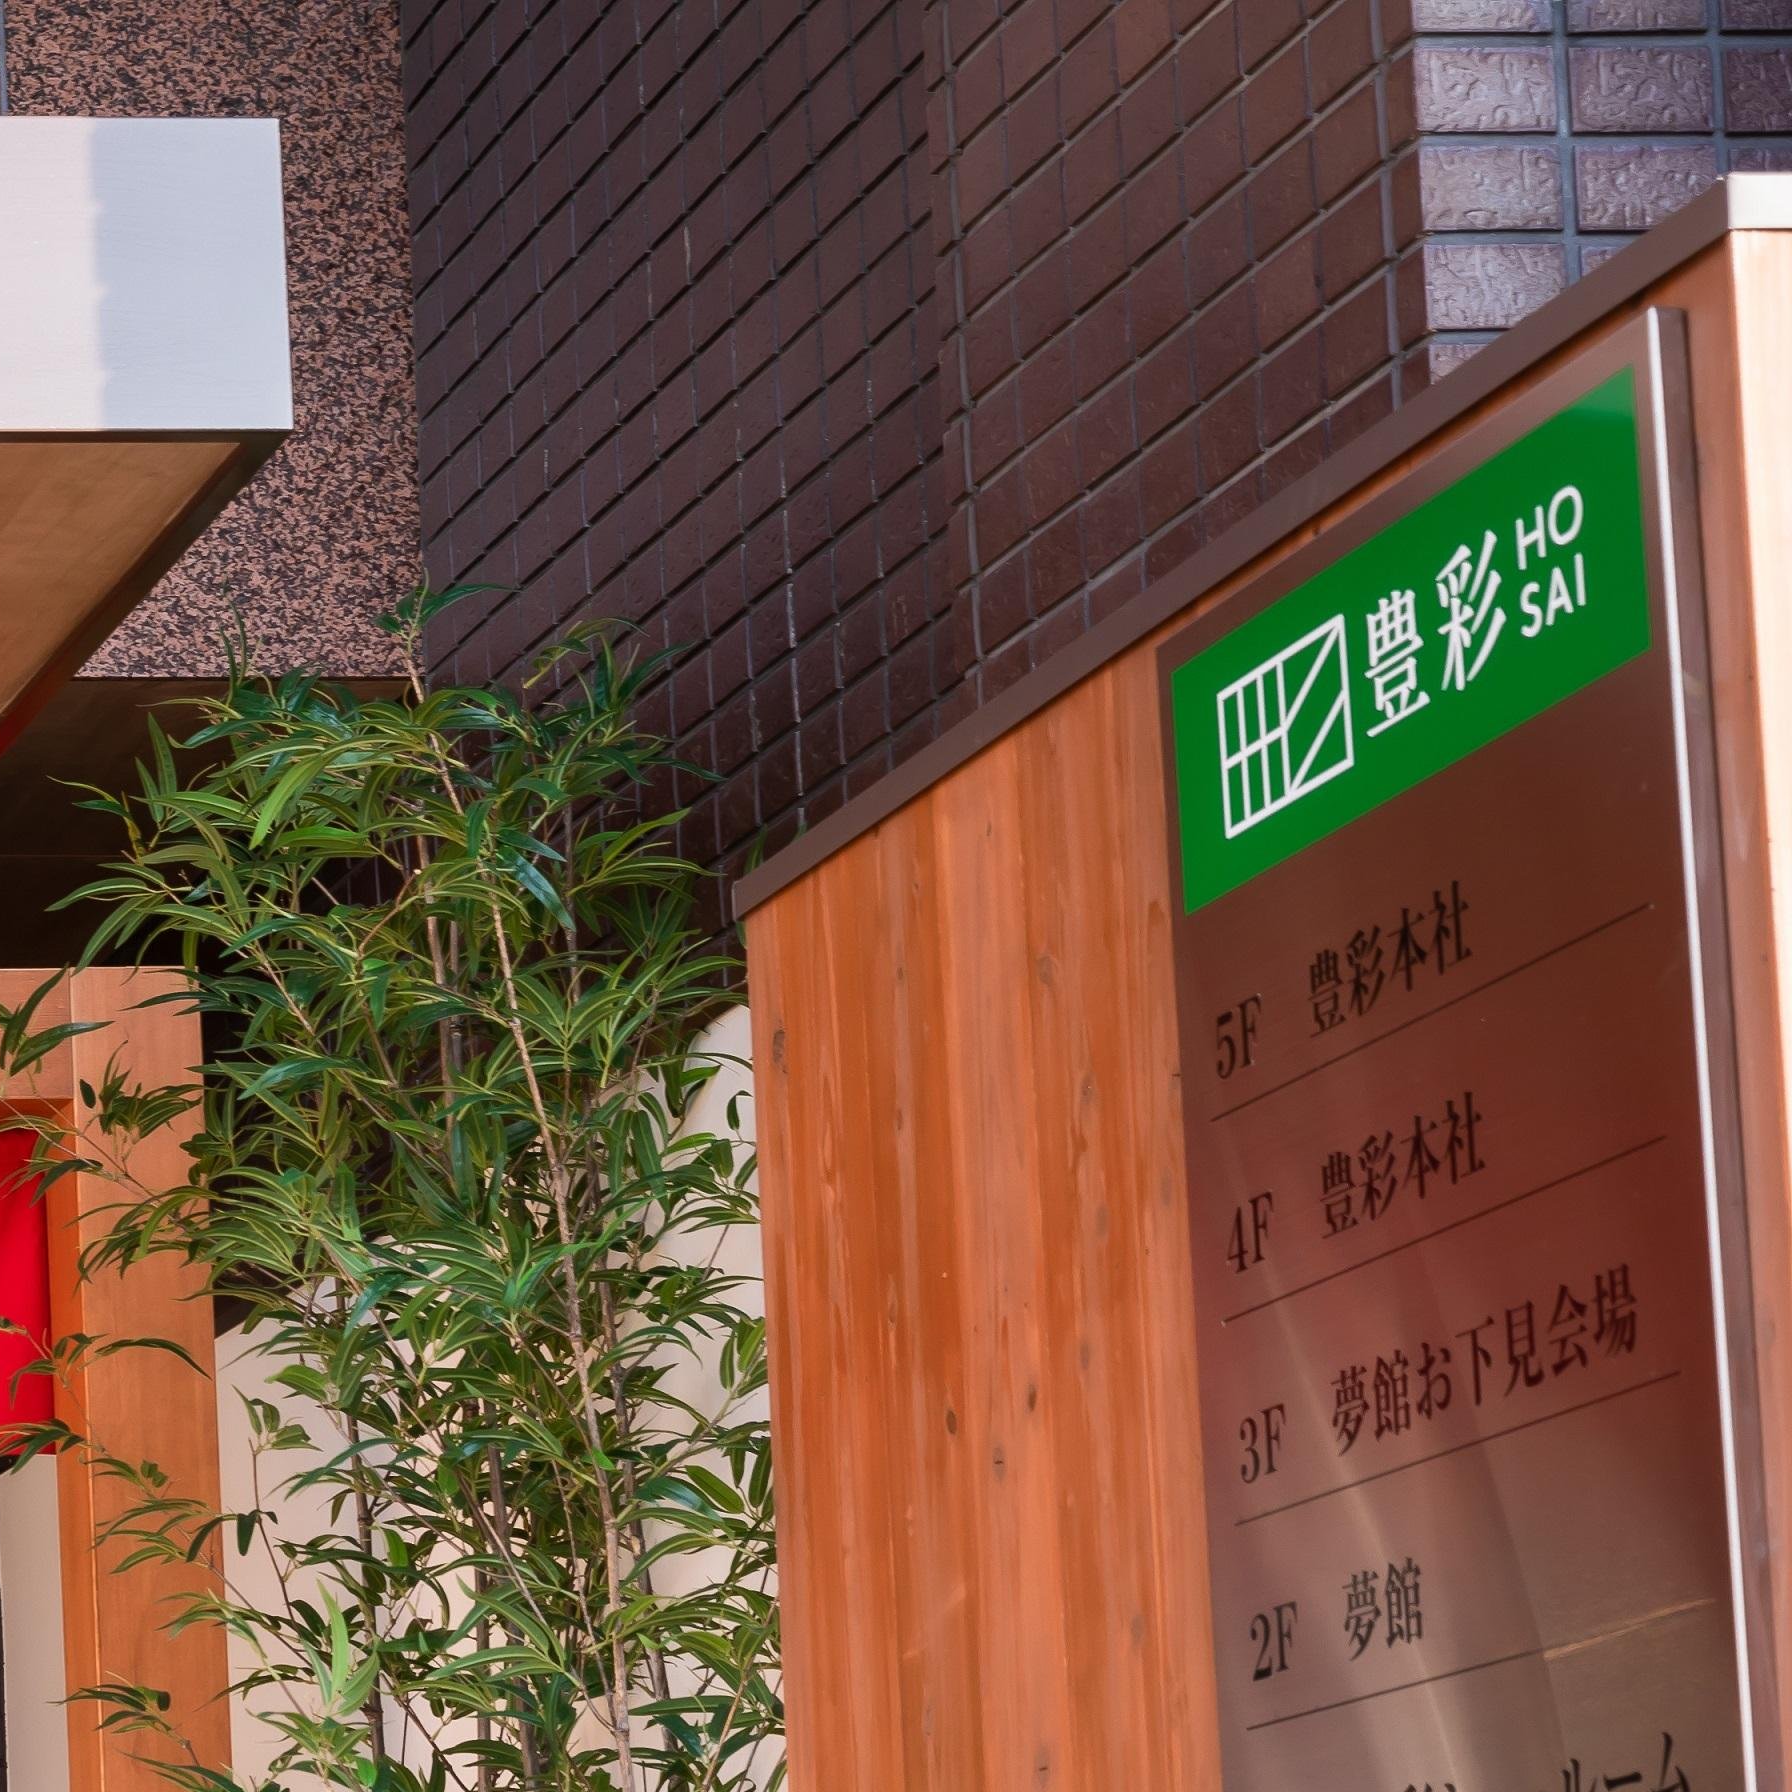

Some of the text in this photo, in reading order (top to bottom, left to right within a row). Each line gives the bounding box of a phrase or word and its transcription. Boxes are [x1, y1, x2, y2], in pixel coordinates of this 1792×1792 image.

[1515, 484, 1585, 571] HO
[1519, 552, 1587, 638] SAI
[1364, 529, 1507, 737] 豊彩
[1215, 880, 1473, 1080] 5F 豊彩本社
[1225, 1091, 1486, 1276] 4F 豊彩本社
[1238, 1263, 1640, 1486] 3F 夢館お下見会場
[1249, 1556, 1424, 1683] 2F 夢館
